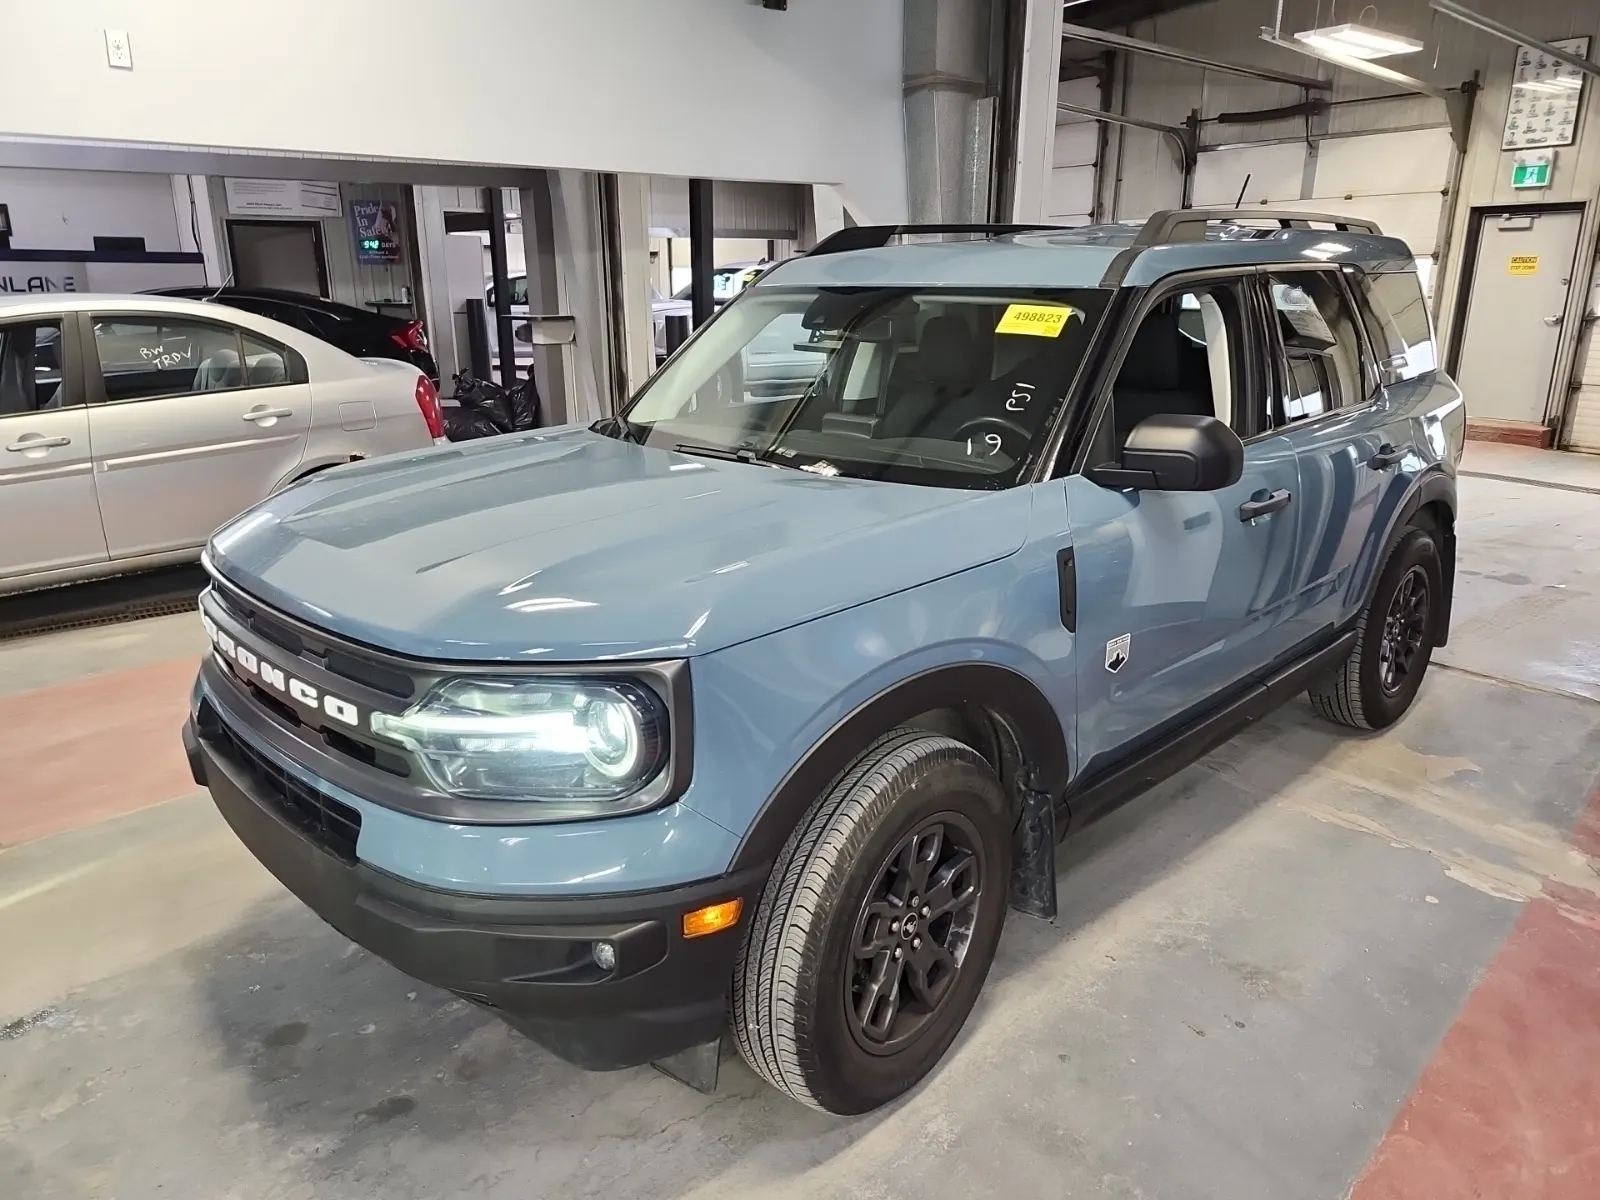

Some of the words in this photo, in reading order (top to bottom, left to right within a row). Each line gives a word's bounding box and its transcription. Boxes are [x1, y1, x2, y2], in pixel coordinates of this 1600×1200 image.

[354, 202, 379, 216] Pride
[356, 216, 369, 227] In
[1013, 311, 1062, 324] 498823
